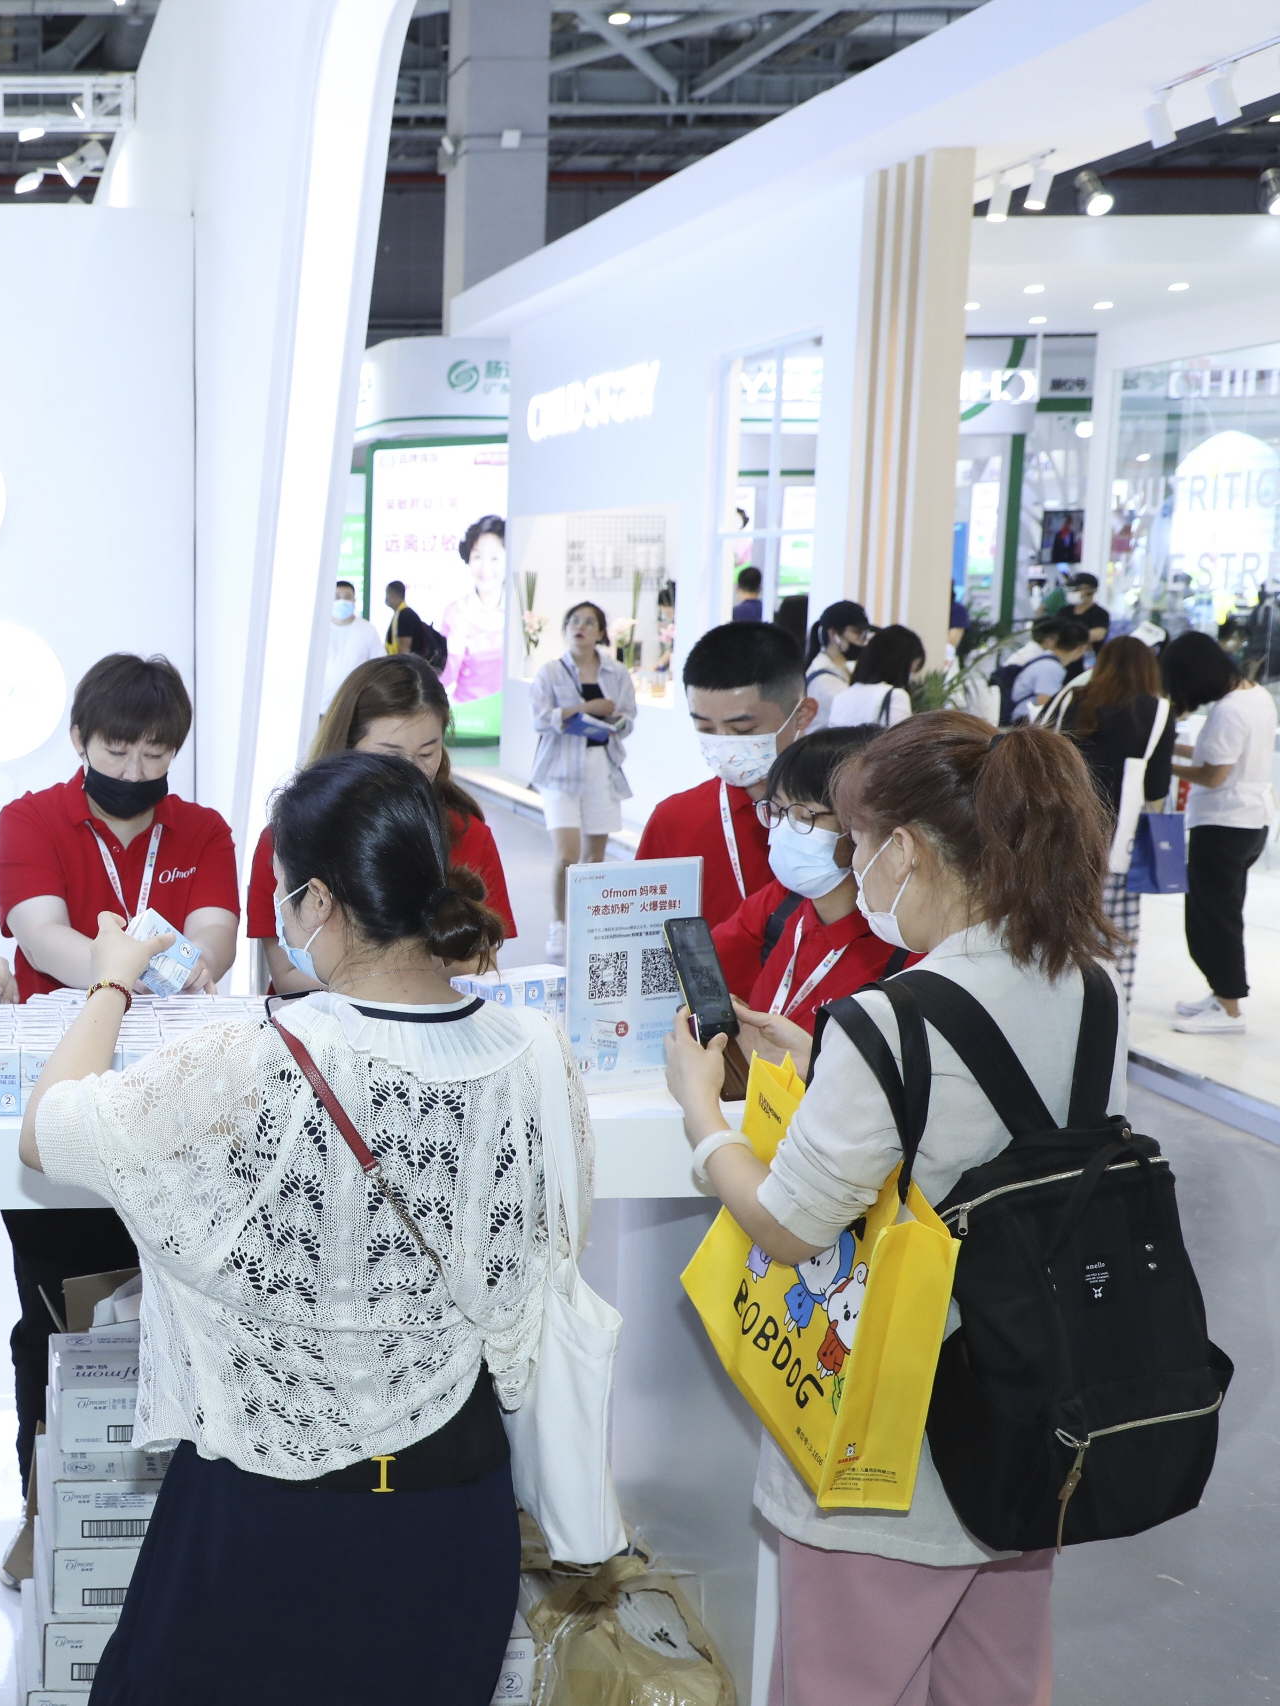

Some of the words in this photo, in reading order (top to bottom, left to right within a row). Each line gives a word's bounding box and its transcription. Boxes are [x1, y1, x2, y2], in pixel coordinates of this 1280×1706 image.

[601, 887, 637, 899] Ofmom
[639, 884, 668, 897] 妈咪爱
[587, 902, 635, 916] “液态奶粉”
[640, 900, 681, 912] 火爆尝鲜!
[5, 1096, 11, 1105] 2
[1085, 1262, 1106, 1270] anello
[506, 1677, 514, 1689] 2
